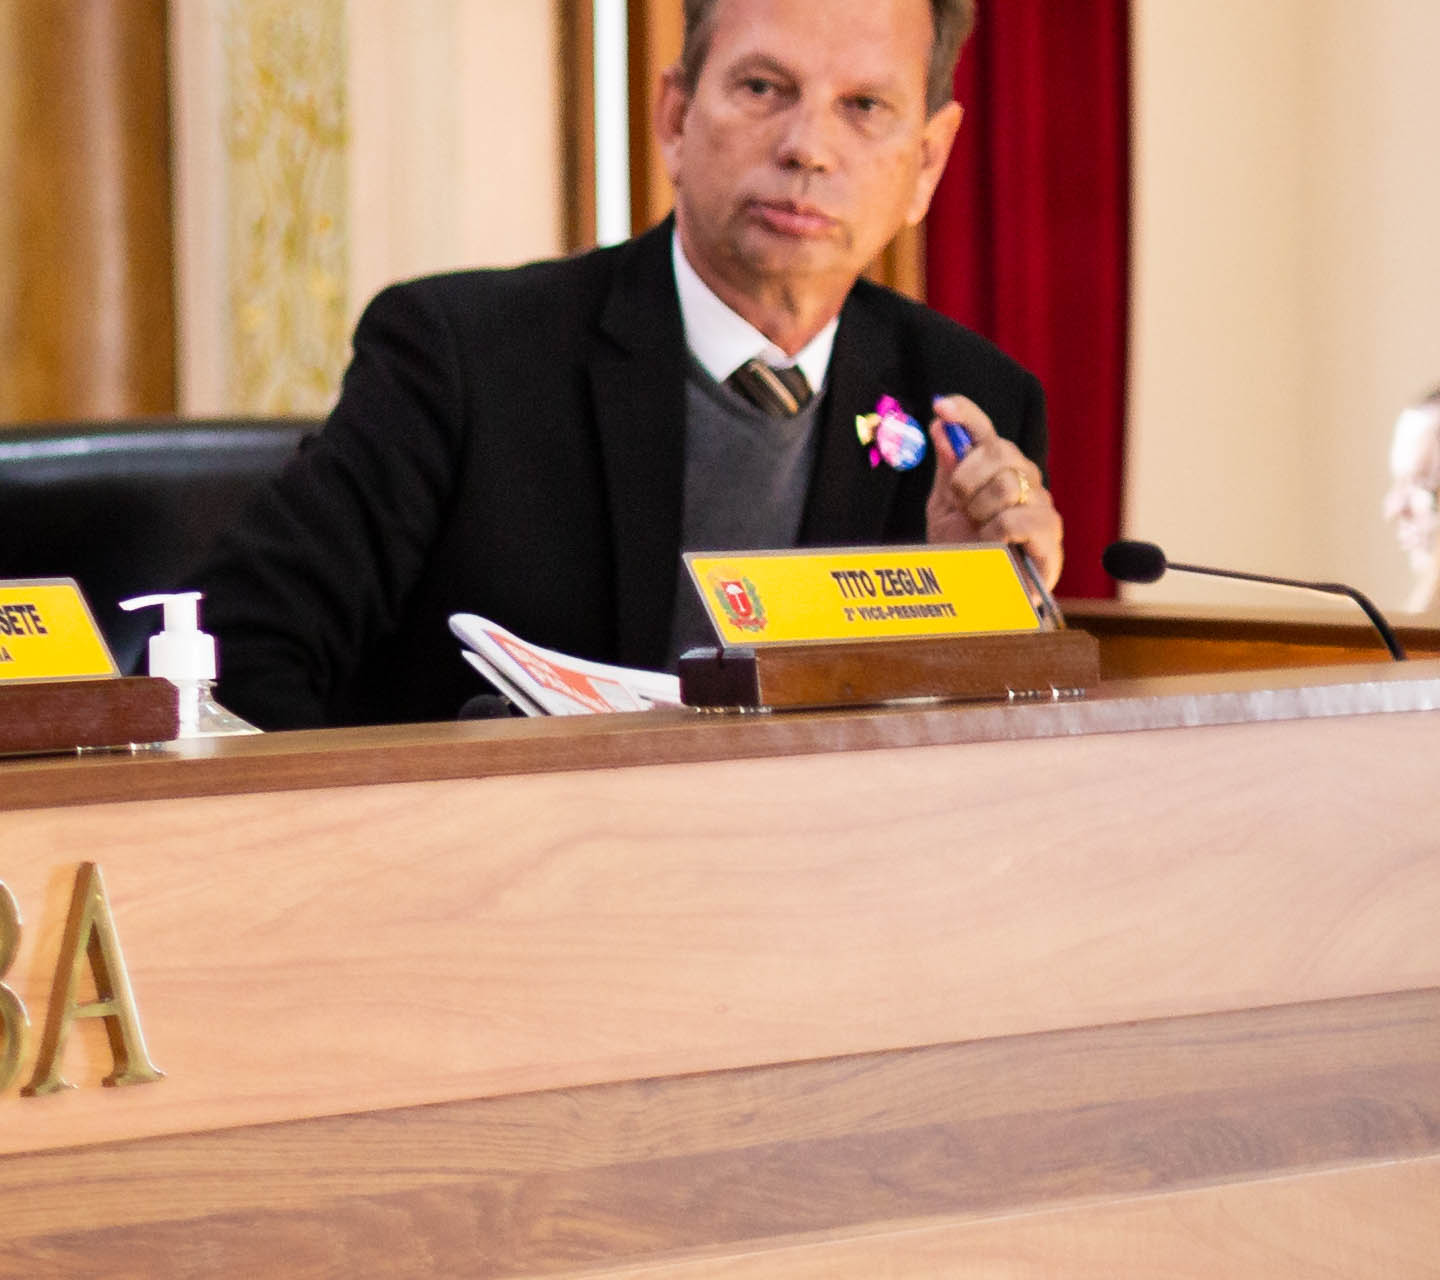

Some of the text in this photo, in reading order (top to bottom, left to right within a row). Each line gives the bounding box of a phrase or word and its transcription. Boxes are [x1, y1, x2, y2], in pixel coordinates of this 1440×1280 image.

[830, 567, 943, 598] TITO ZEGLIN
[856, 602, 958, 621] VICE-PRESIDENTE
